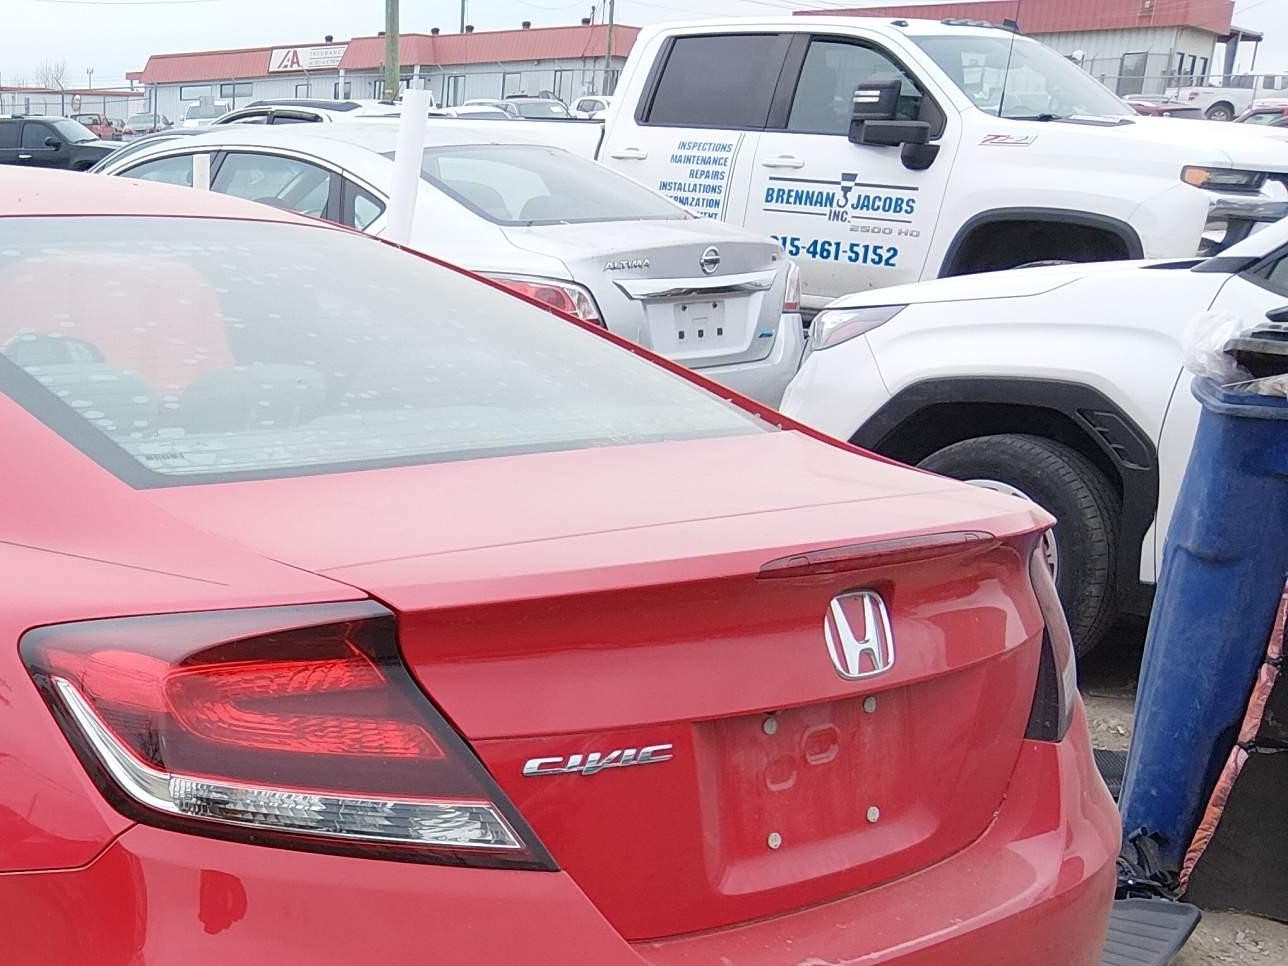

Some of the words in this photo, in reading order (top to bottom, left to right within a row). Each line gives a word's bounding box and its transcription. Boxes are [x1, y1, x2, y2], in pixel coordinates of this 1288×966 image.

[677, 141, 733, 152] INSPECTIONS
[670, 154, 729, 166] MAINTENANCE
[688, 169, 726, 180] REPAIRS
[659, 181, 723, 194] INSTALLATIONS
[764, 187, 835, 208] BRENNAN
[850, 194, 916, 215] JACOBS
[828, 209, 851, 223] INC.
[849, 224, 893, 235] 2500
[897, 228, 920, 238] HD
[603, 258, 650, 271] ALTIMA
[523, 744, 673, 776] CIVIC
